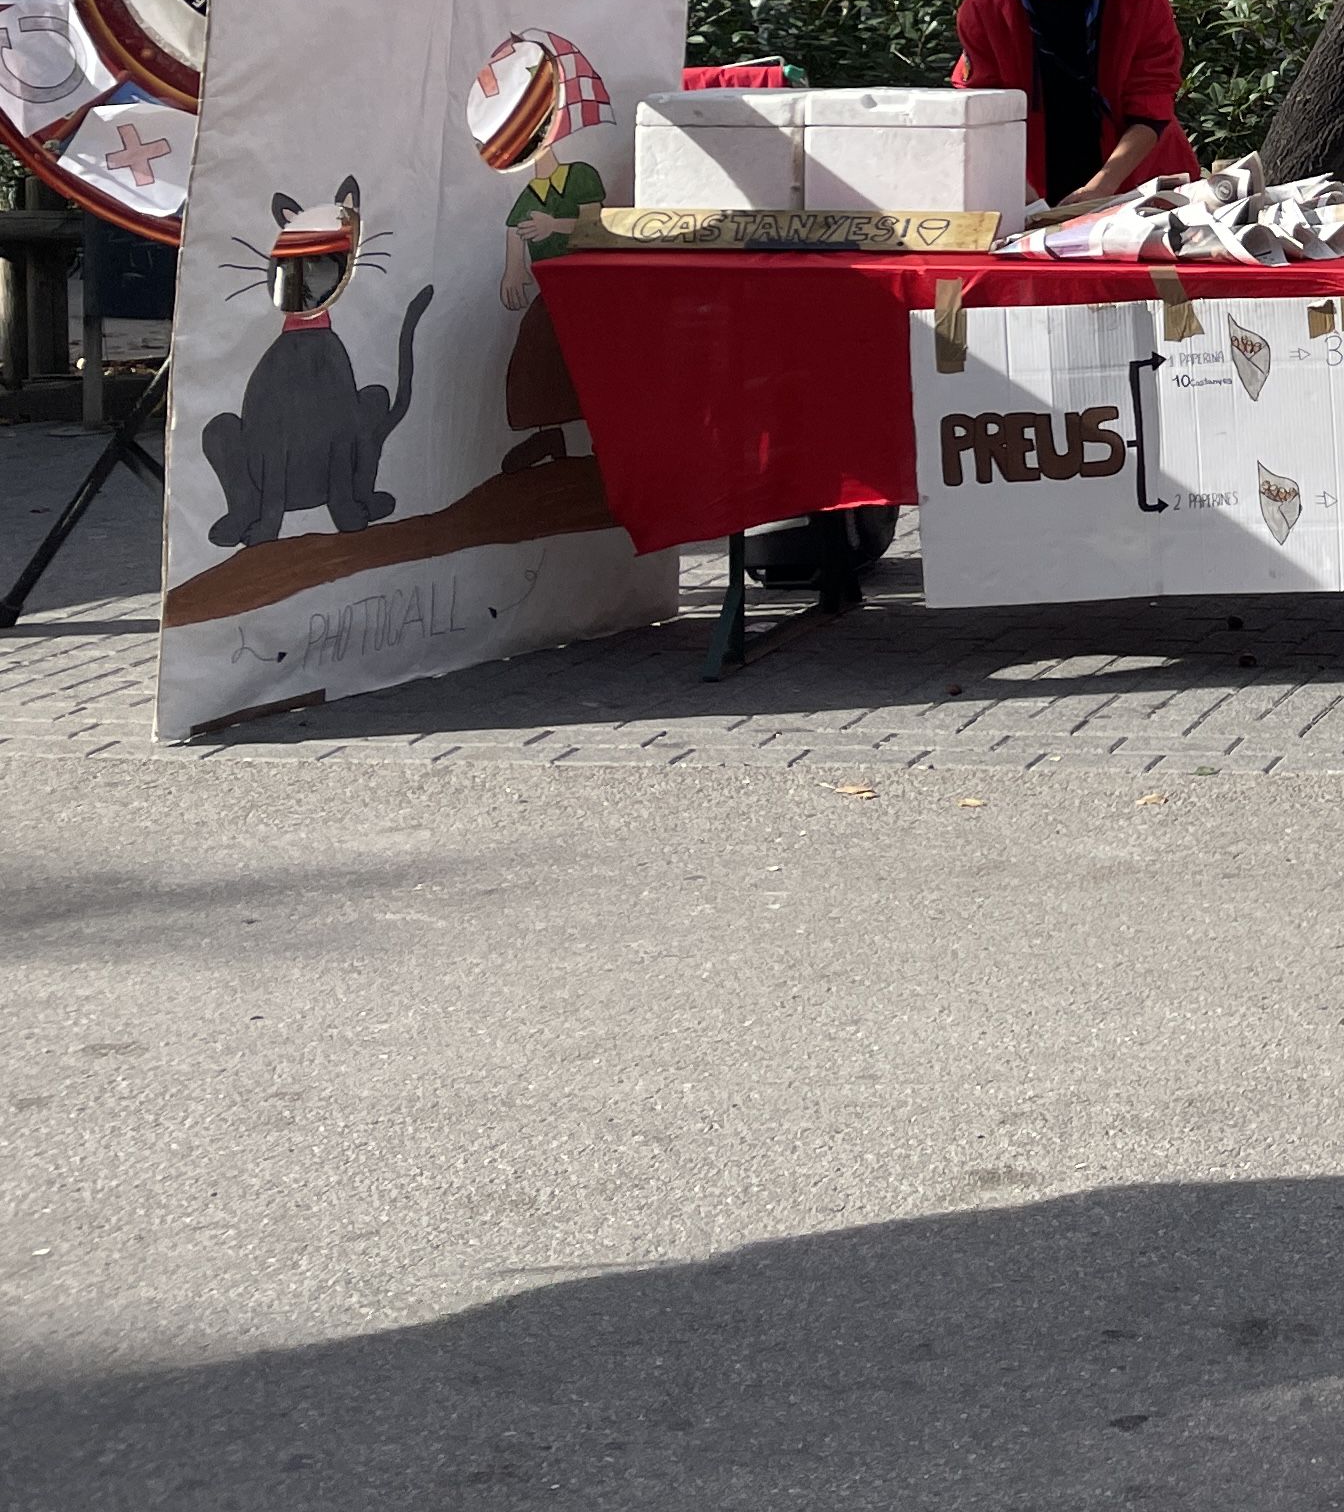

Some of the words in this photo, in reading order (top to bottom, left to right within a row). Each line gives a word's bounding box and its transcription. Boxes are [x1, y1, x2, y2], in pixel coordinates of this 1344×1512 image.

[631, 211, 909, 247] CASTANYES!
[1172, 374, 1190, 387] 10
[941, 406, 1126, 486] PREUS
[1173, 493, 1182, 510] 2
[1188, 492, 1239, 509] PAPERINES
[302, 575, 466, 671] PHOTOCALL
